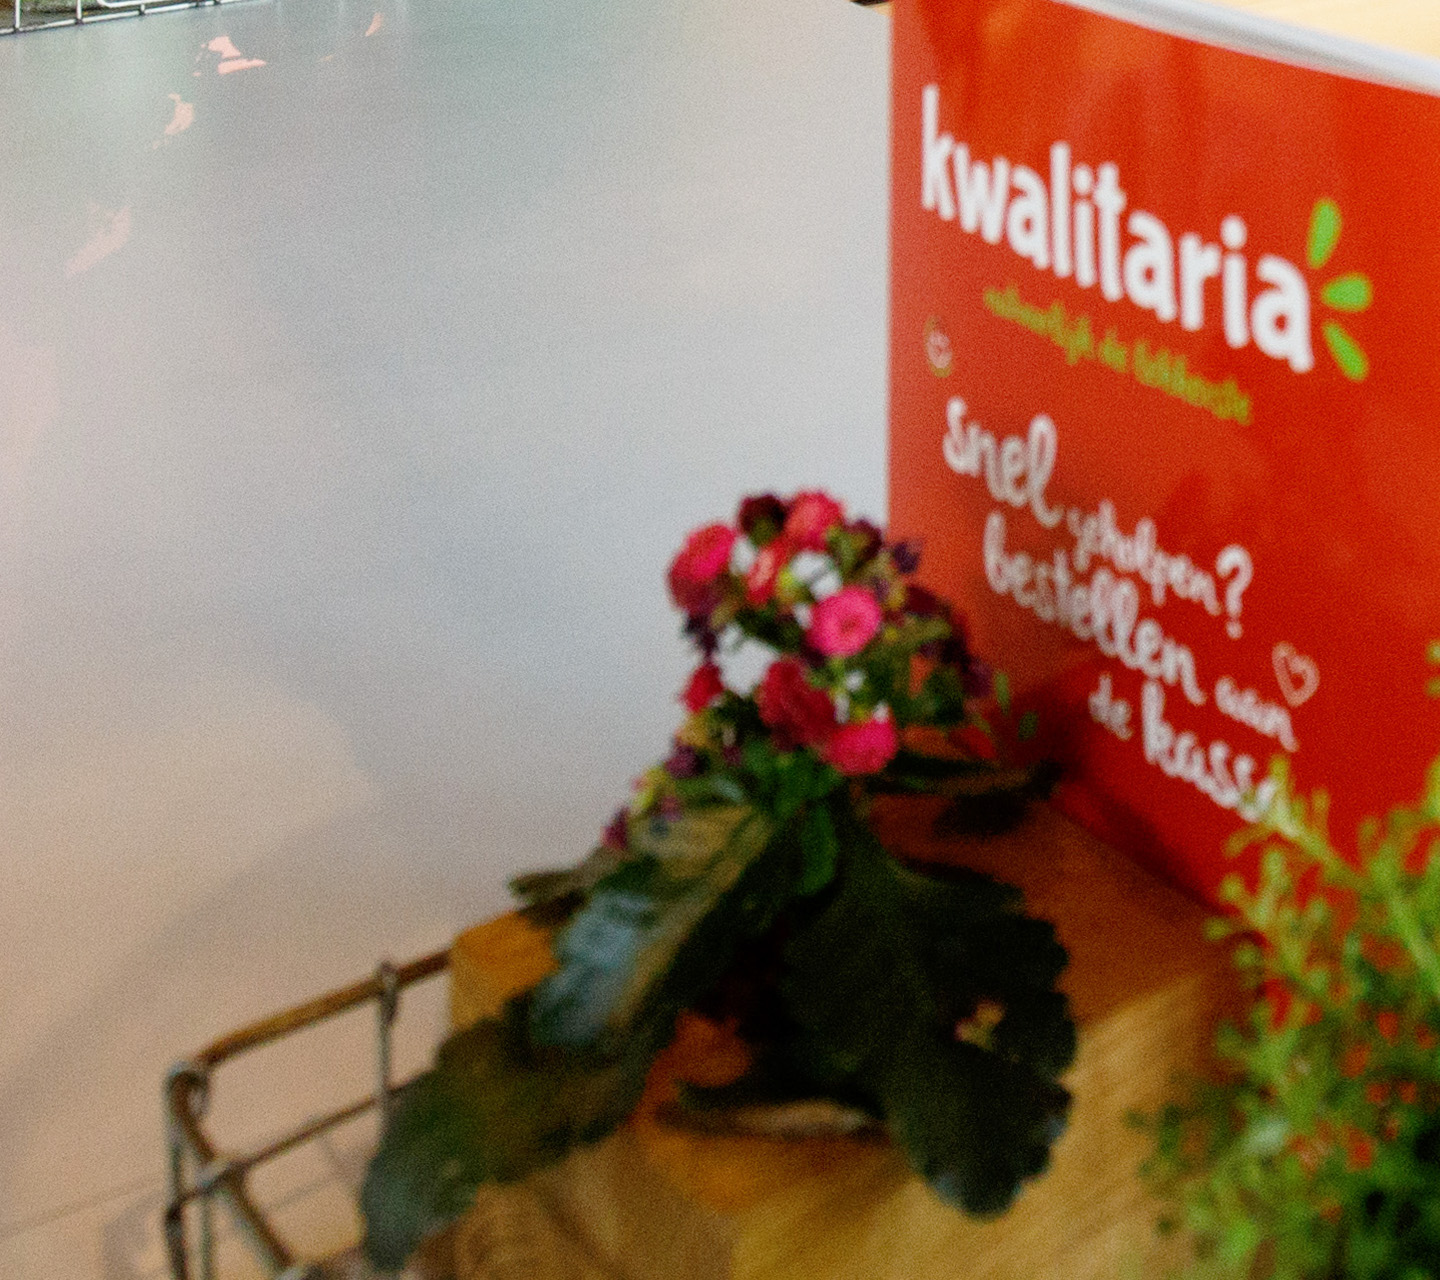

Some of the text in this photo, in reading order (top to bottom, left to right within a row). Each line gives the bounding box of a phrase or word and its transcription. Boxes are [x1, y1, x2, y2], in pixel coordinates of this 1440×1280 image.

[920, 83, 1315, 373] kwalitaria
[983, 514, 1299, 753] bestellen aan
